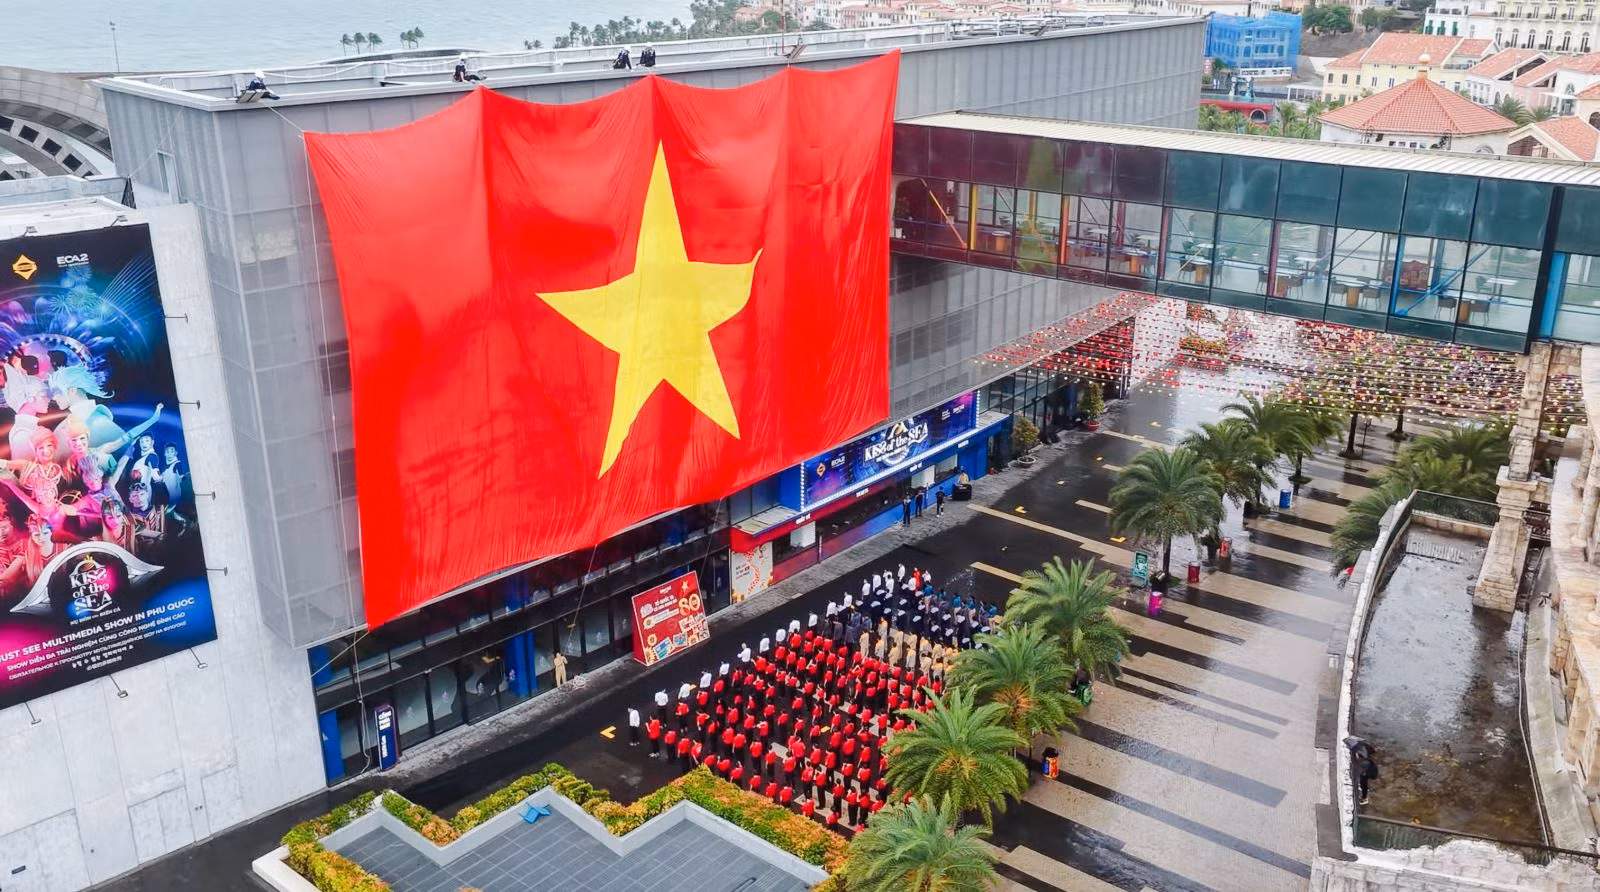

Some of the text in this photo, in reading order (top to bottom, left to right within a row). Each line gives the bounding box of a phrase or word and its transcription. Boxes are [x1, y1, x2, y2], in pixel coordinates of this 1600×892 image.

[57, 253, 89, 264] ECA2
[70, 567, 107, 588] KISS
[73, 582, 110, 598] of the
[74, 591, 112, 609] SEA
[0, 597, 195, 662] UST SEE MULTIMEDIA SHOW IN PHU QUOC
[7, 660, 28, 671] SHOW
[98, 633, 117, 643] CÙNG
[118, 627, 137, 637] CÔNG
[172, 611, 186, 620] CAO
